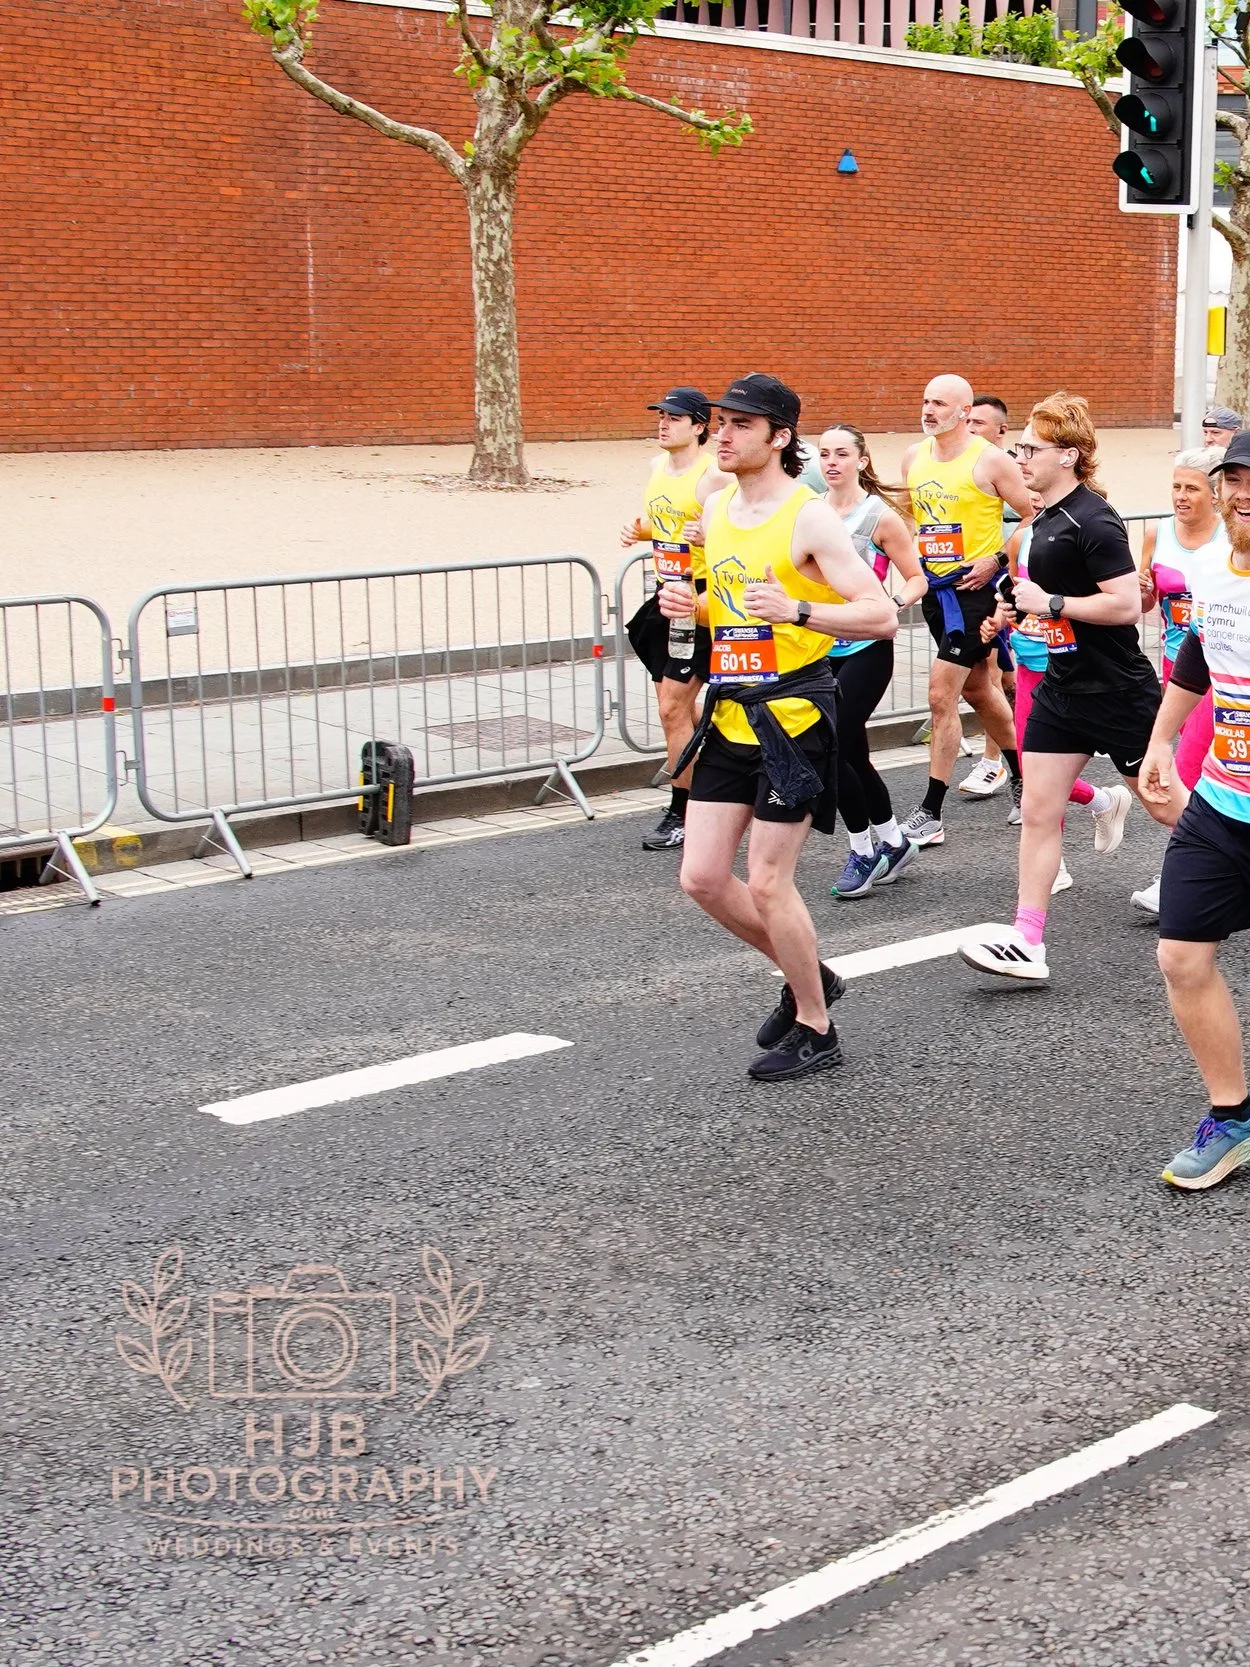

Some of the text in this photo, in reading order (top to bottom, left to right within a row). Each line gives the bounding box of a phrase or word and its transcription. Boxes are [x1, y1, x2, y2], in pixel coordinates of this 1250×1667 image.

[925, 541, 954, 555] 6032
[1208, 602, 1247, 617] ymchwil
[1206, 616, 1236, 628] cymru
[1206, 628, 1235, 641] cancer
[713, 643, 732, 652] JACOB
[720, 653, 763, 671] 6015
